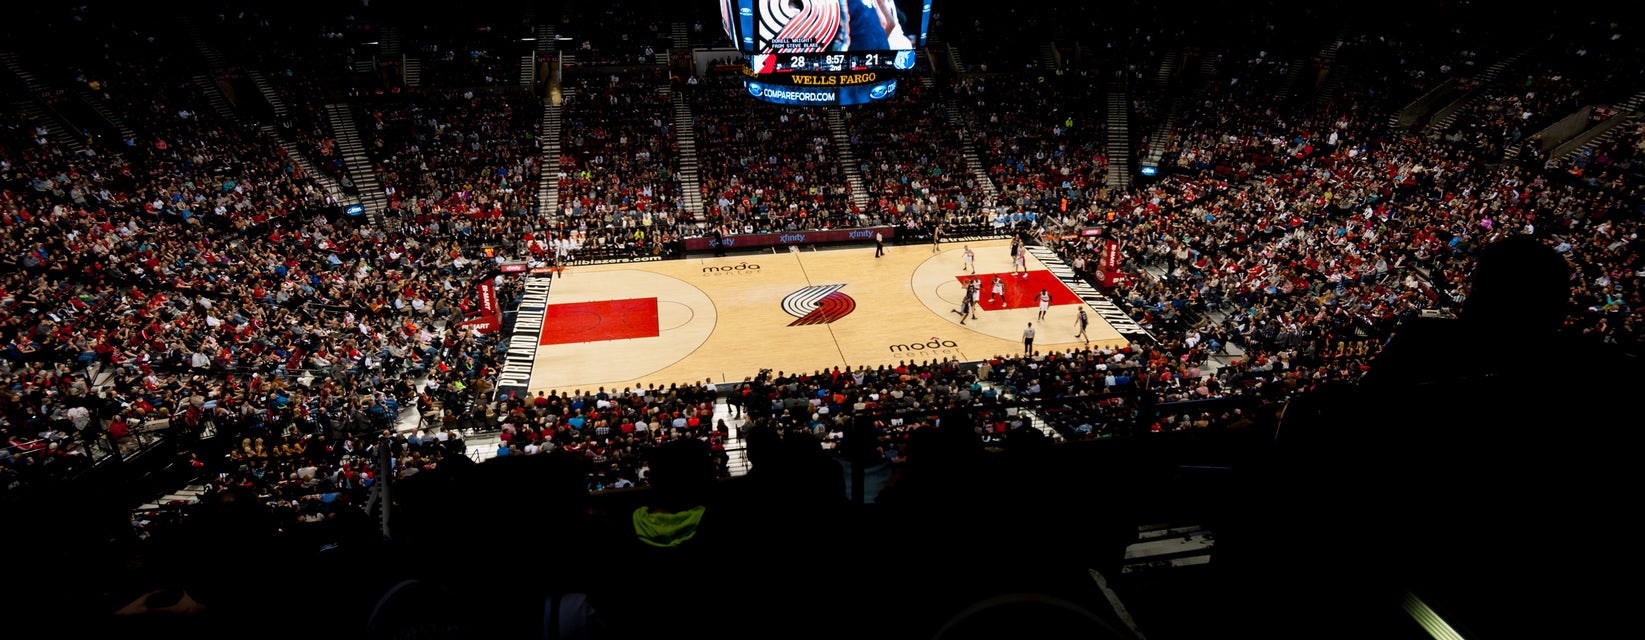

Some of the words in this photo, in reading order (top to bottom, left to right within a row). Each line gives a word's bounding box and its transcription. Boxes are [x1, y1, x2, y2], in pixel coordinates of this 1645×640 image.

[790, 55, 805, 68] 28
[826, 54, 845, 64] 8:57
[865, 53, 879, 66] 21
[829, 64, 842, 72] 2nd
[791, 75, 837, 85] WELLS
[840, 72, 876, 85] FARGO
[763, 88, 836, 102] COMPAREFORD.COM
[779, 232, 805, 243] xfinity
[848, 228, 874, 240] xfinity
[702, 262, 761, 273] moda
[702, 269, 761, 277] center
[519, 276, 552, 307] BLAZERS
[513, 309, 544, 333] TRAIL
[889, 338, 958, 353] moda
[893, 349, 960, 359] center
[498, 335, 538, 387] PORTLAND
